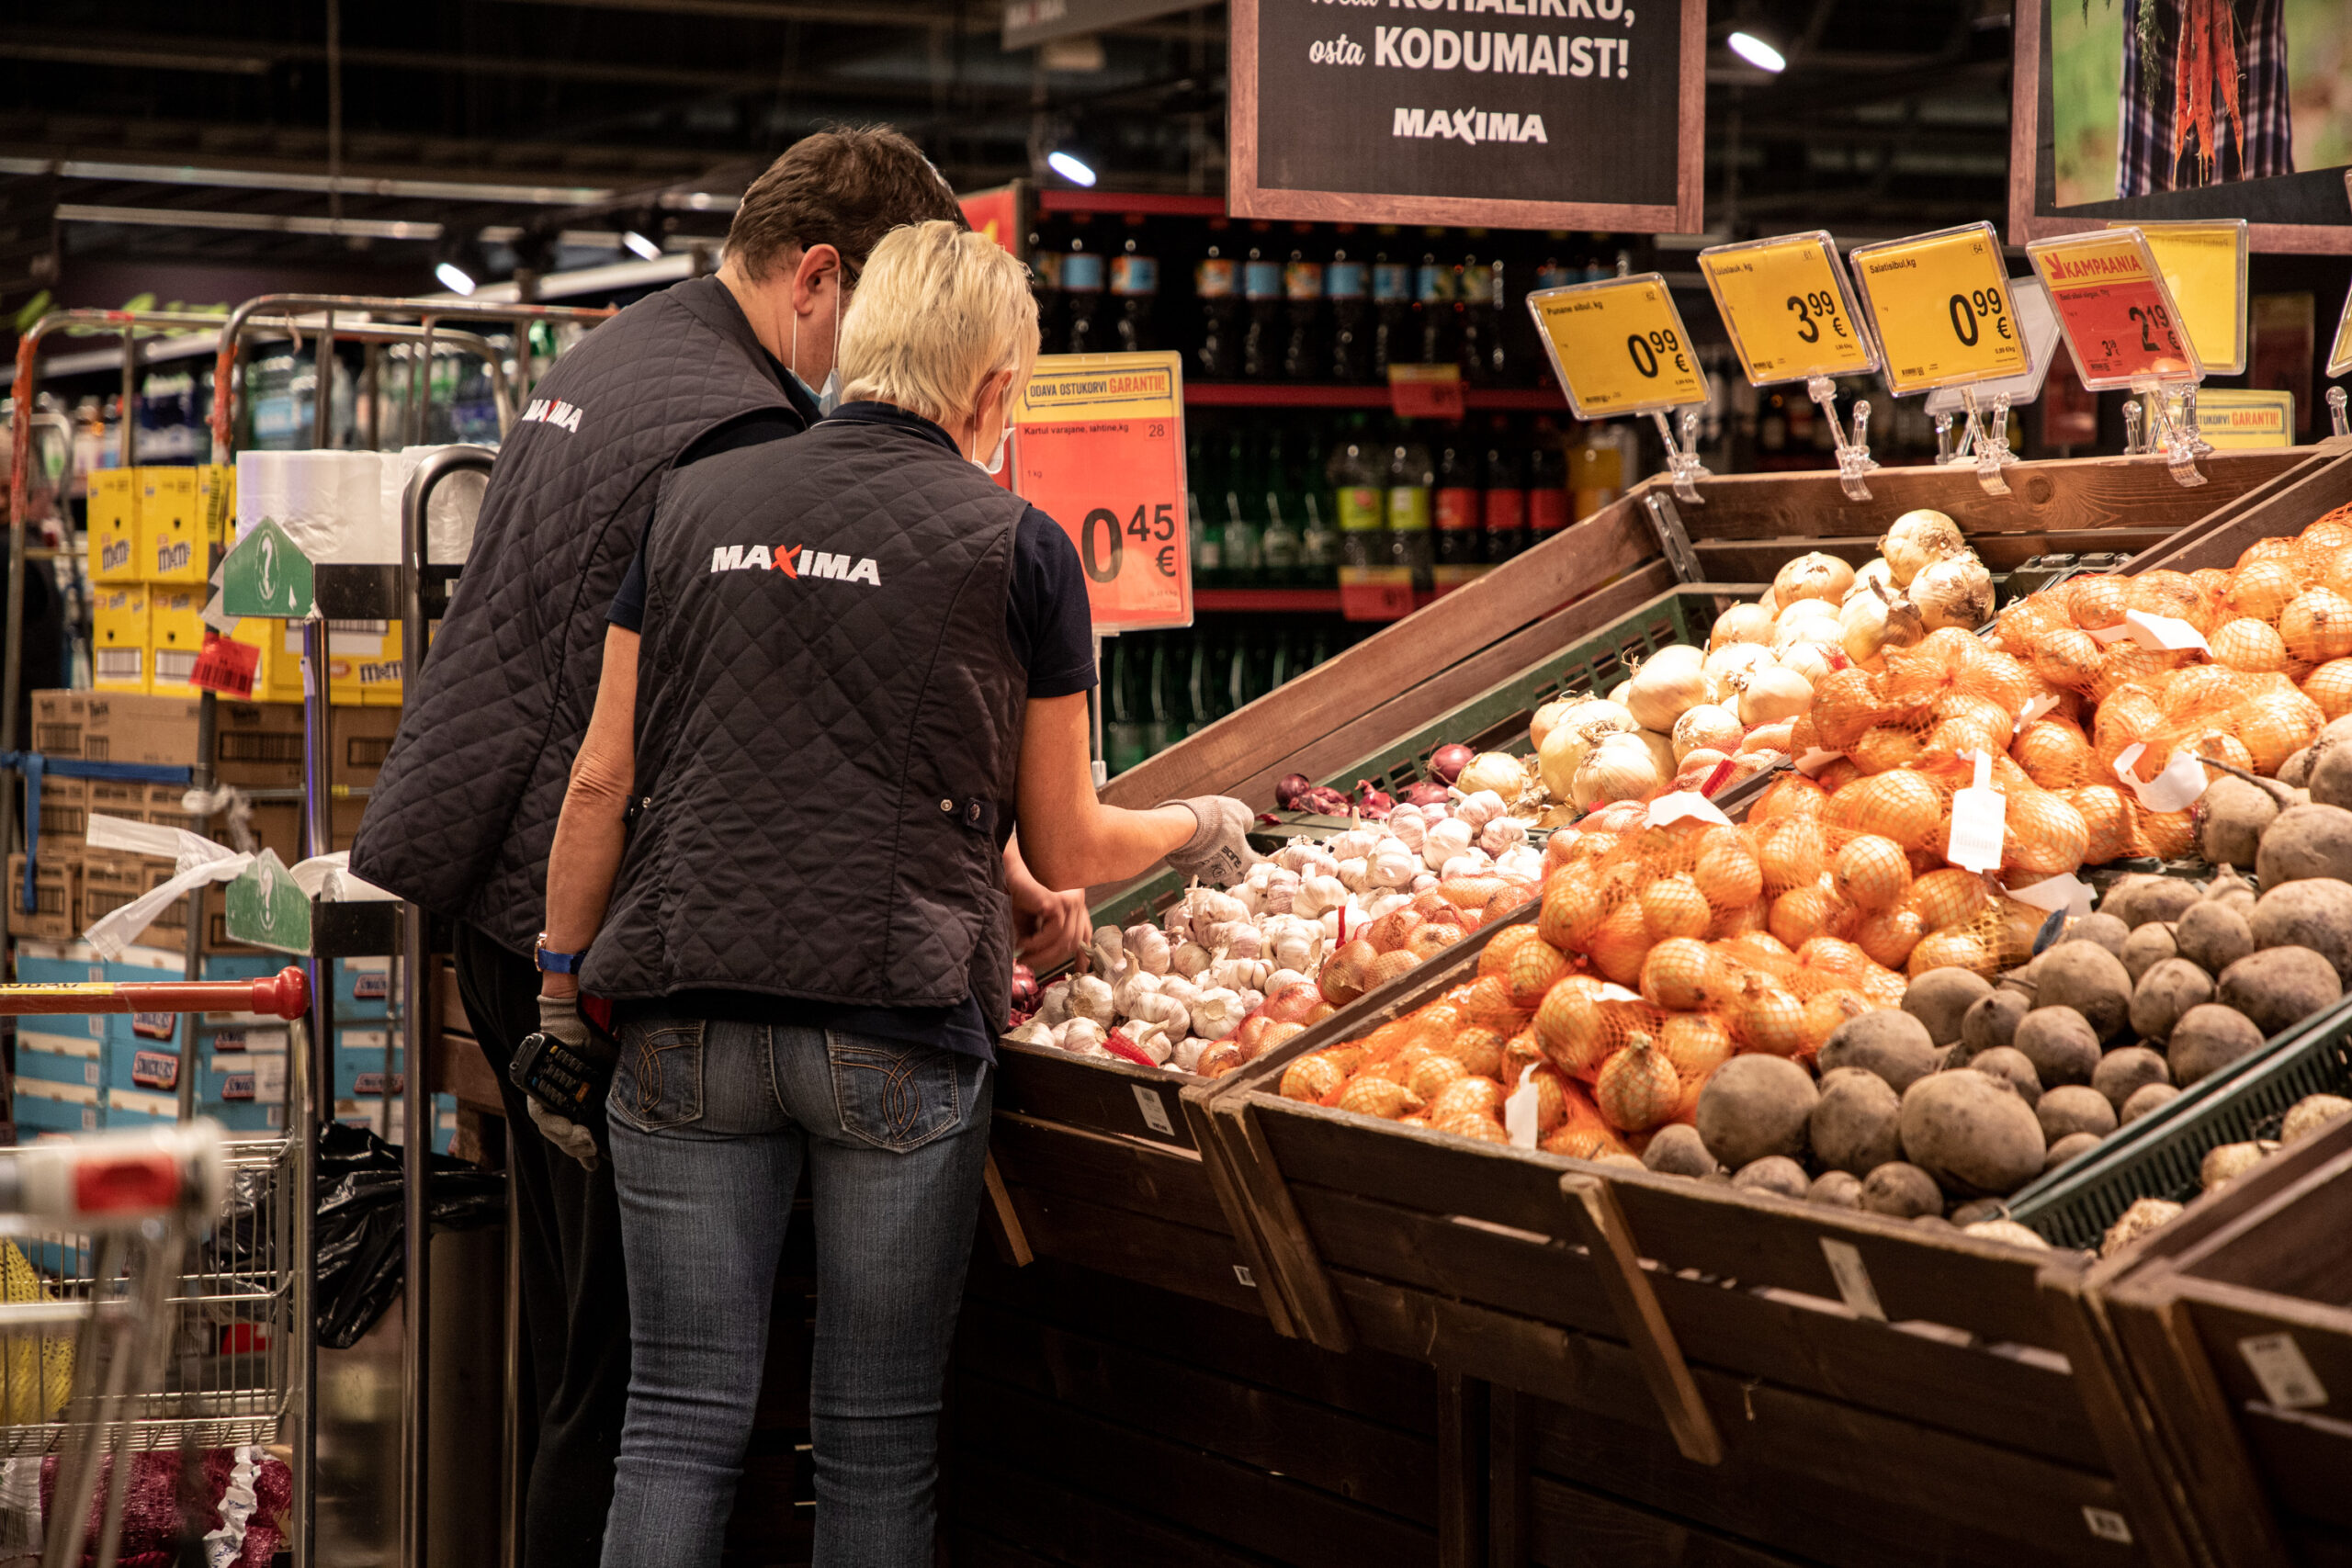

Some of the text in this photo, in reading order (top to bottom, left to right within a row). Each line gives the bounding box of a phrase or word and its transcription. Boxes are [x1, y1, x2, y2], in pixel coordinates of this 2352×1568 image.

[1309, 26, 1630, 80] osta KODUMAIST!
[1392, 106, 1548, 144] MAXIMA
[1973, 243, 1984, 254] 64
[2062, 254, 2143, 278] KAMPAANIA
[1594, 299, 1604, 310] kg
[1030, 374, 1165, 398] ODAVA OSTUKORVI GARANTII!
[521, 397, 584, 434] MAXIMA
[2198, 414, 2230, 425] TUKORVI
[2232, 411, 2279, 427] GARANTII!
[1023, 426, 1049, 435] Kartul
[1050, 425, 1089, 436] varajane,
[1148, 424, 1165, 438] 28
[710, 543, 882, 587] MAXIMA
